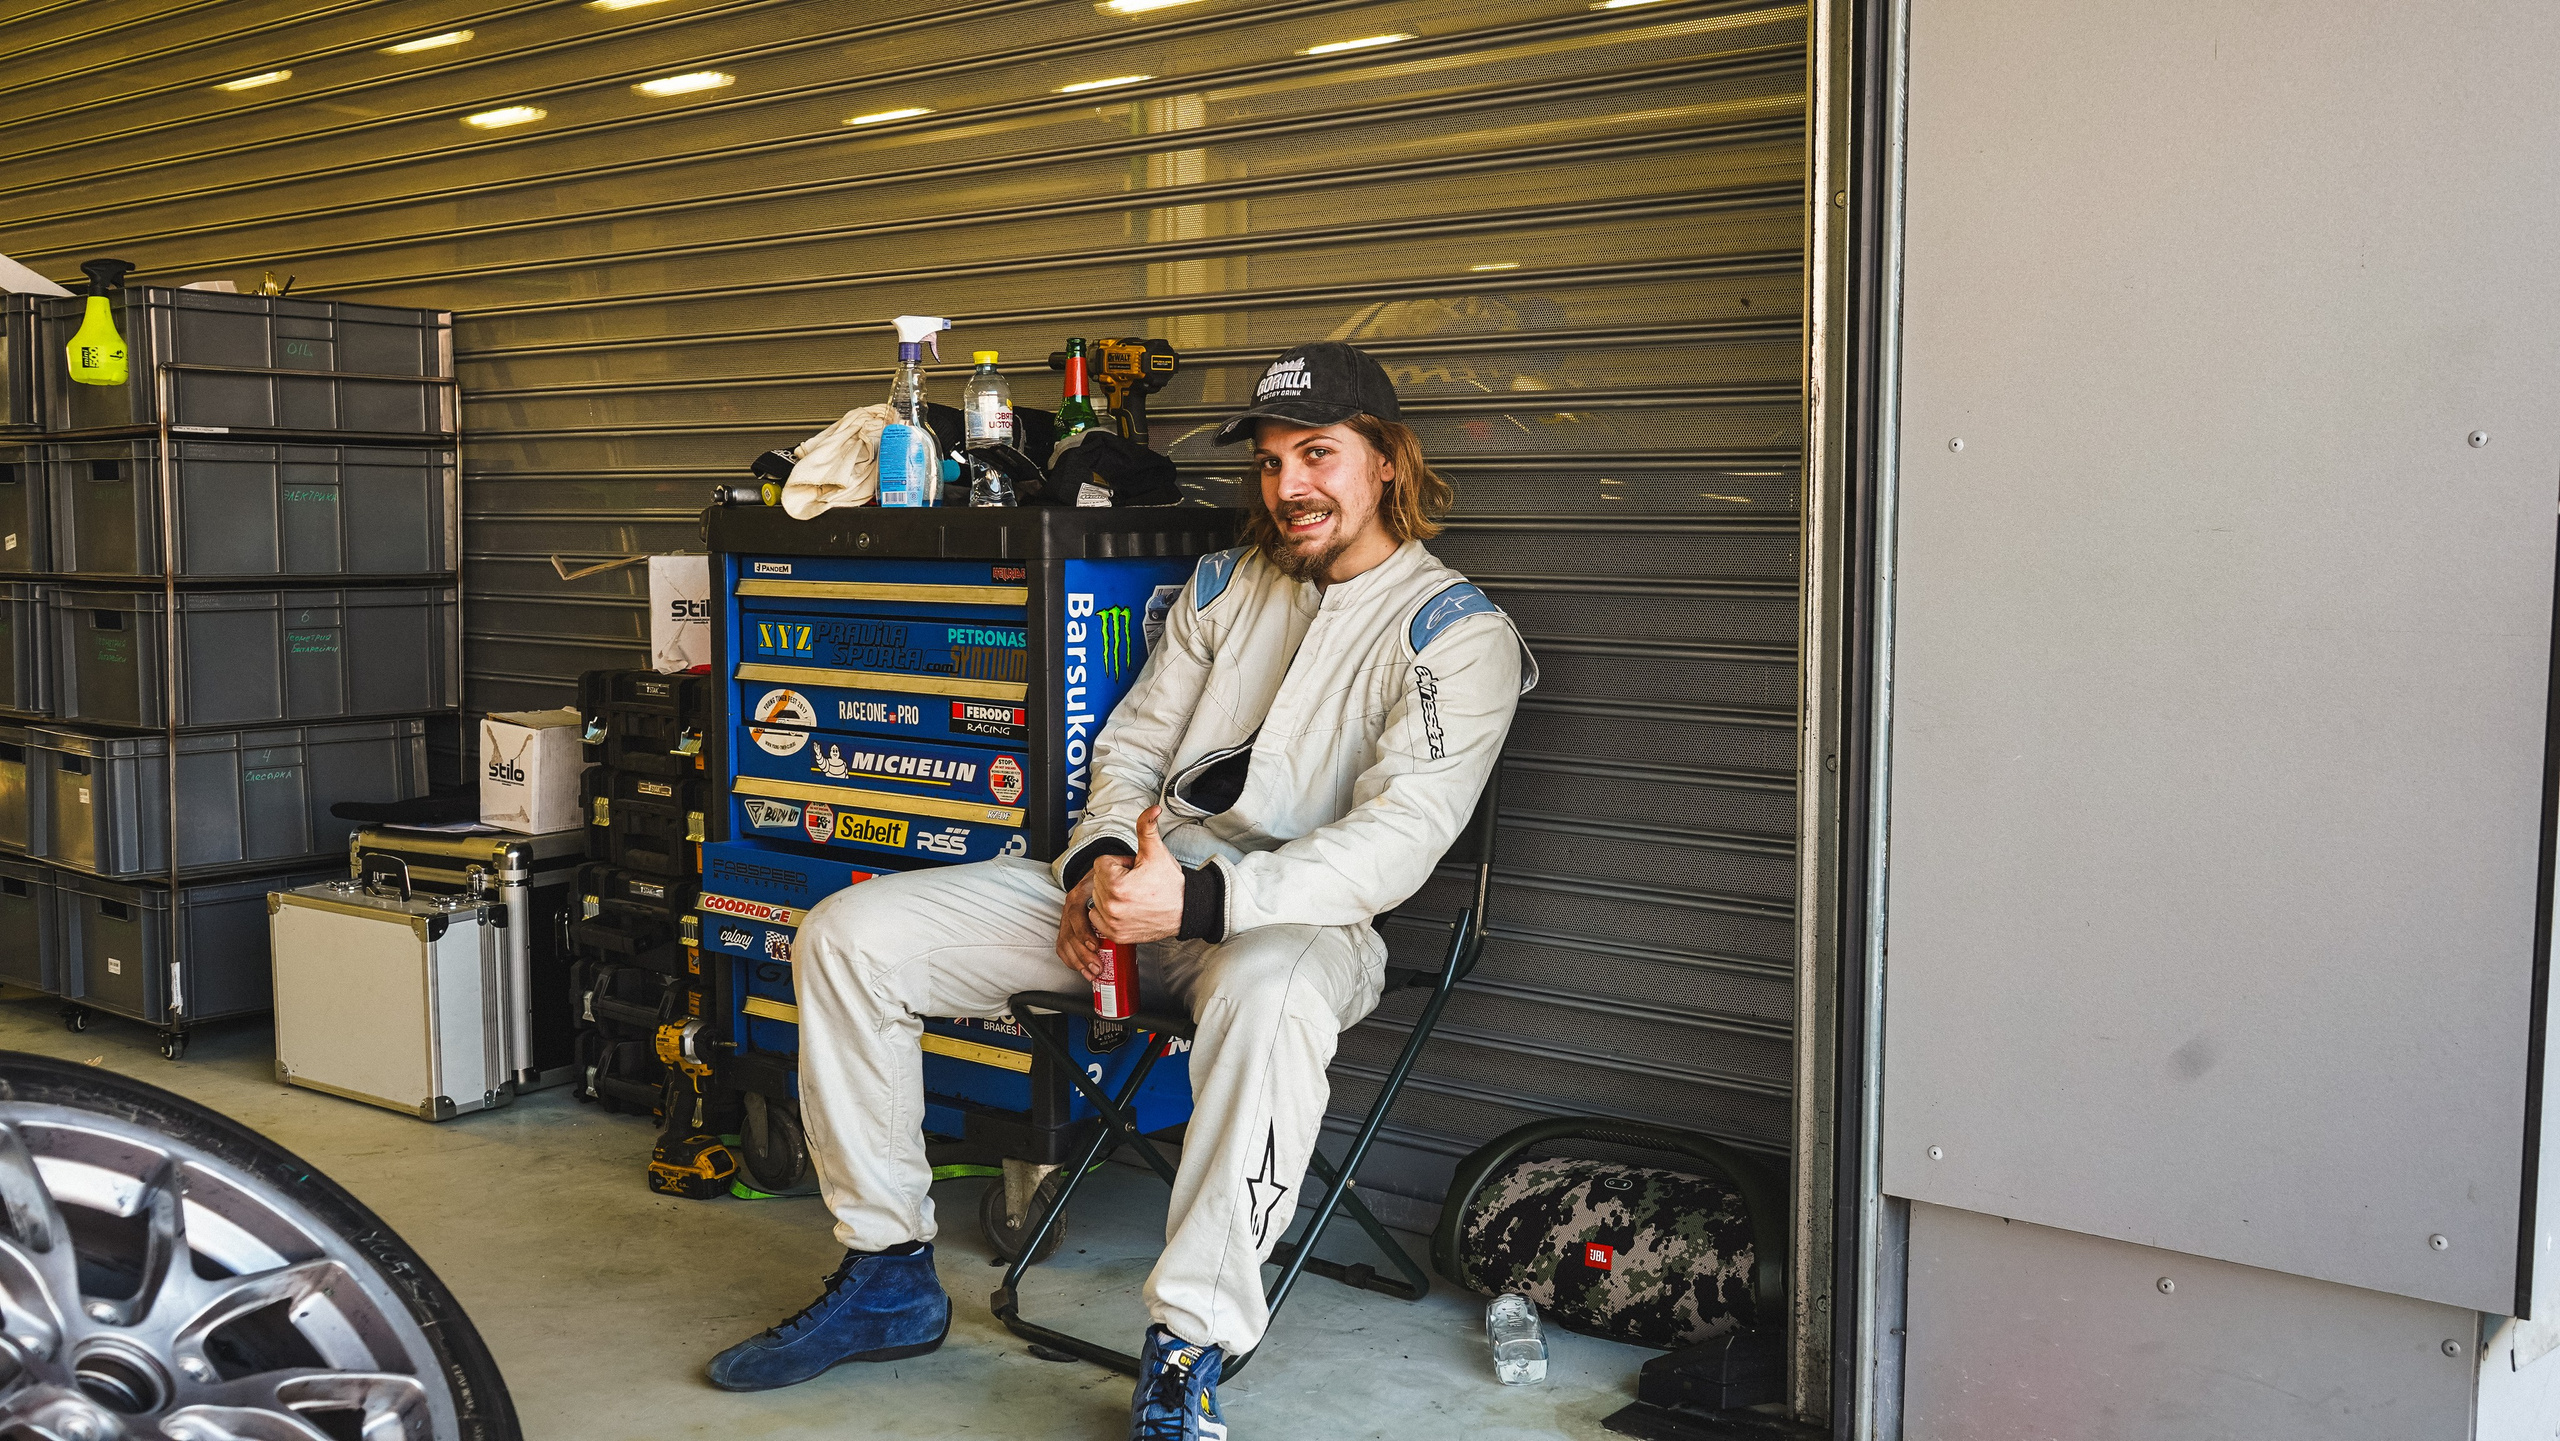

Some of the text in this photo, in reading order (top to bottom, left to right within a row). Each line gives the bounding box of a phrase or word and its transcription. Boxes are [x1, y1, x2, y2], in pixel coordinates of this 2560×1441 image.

[1257, 371, 1312, 397] GORILLA
[1281, 389, 1302, 397] DRINK
[758, 623, 812, 651] XYZ
[947, 628, 1027, 648] PETRONAS
[949, 645, 1027, 681] SYNTIUM
[897, 705, 919, 725] PRO
[966, 706, 1011, 722] FERODO
[966, 723, 1010, 736] RACING
[489, 759, 525, 782] Stilo
[851, 752, 977, 782] MICHELIN
[840, 817, 902, 845] Sabelt
[917, 830, 968, 856] RSS
[713, 858, 809, 885] FABSPEED
[713, 872, 809, 894] MOTORSPORT
[704, 896, 791, 924] GOODRIDGE
[720, 929, 754, 948] colony
[983, 1020, 1018, 1036] BRAKES
[1590, 1249, 1607, 1263] JBL
